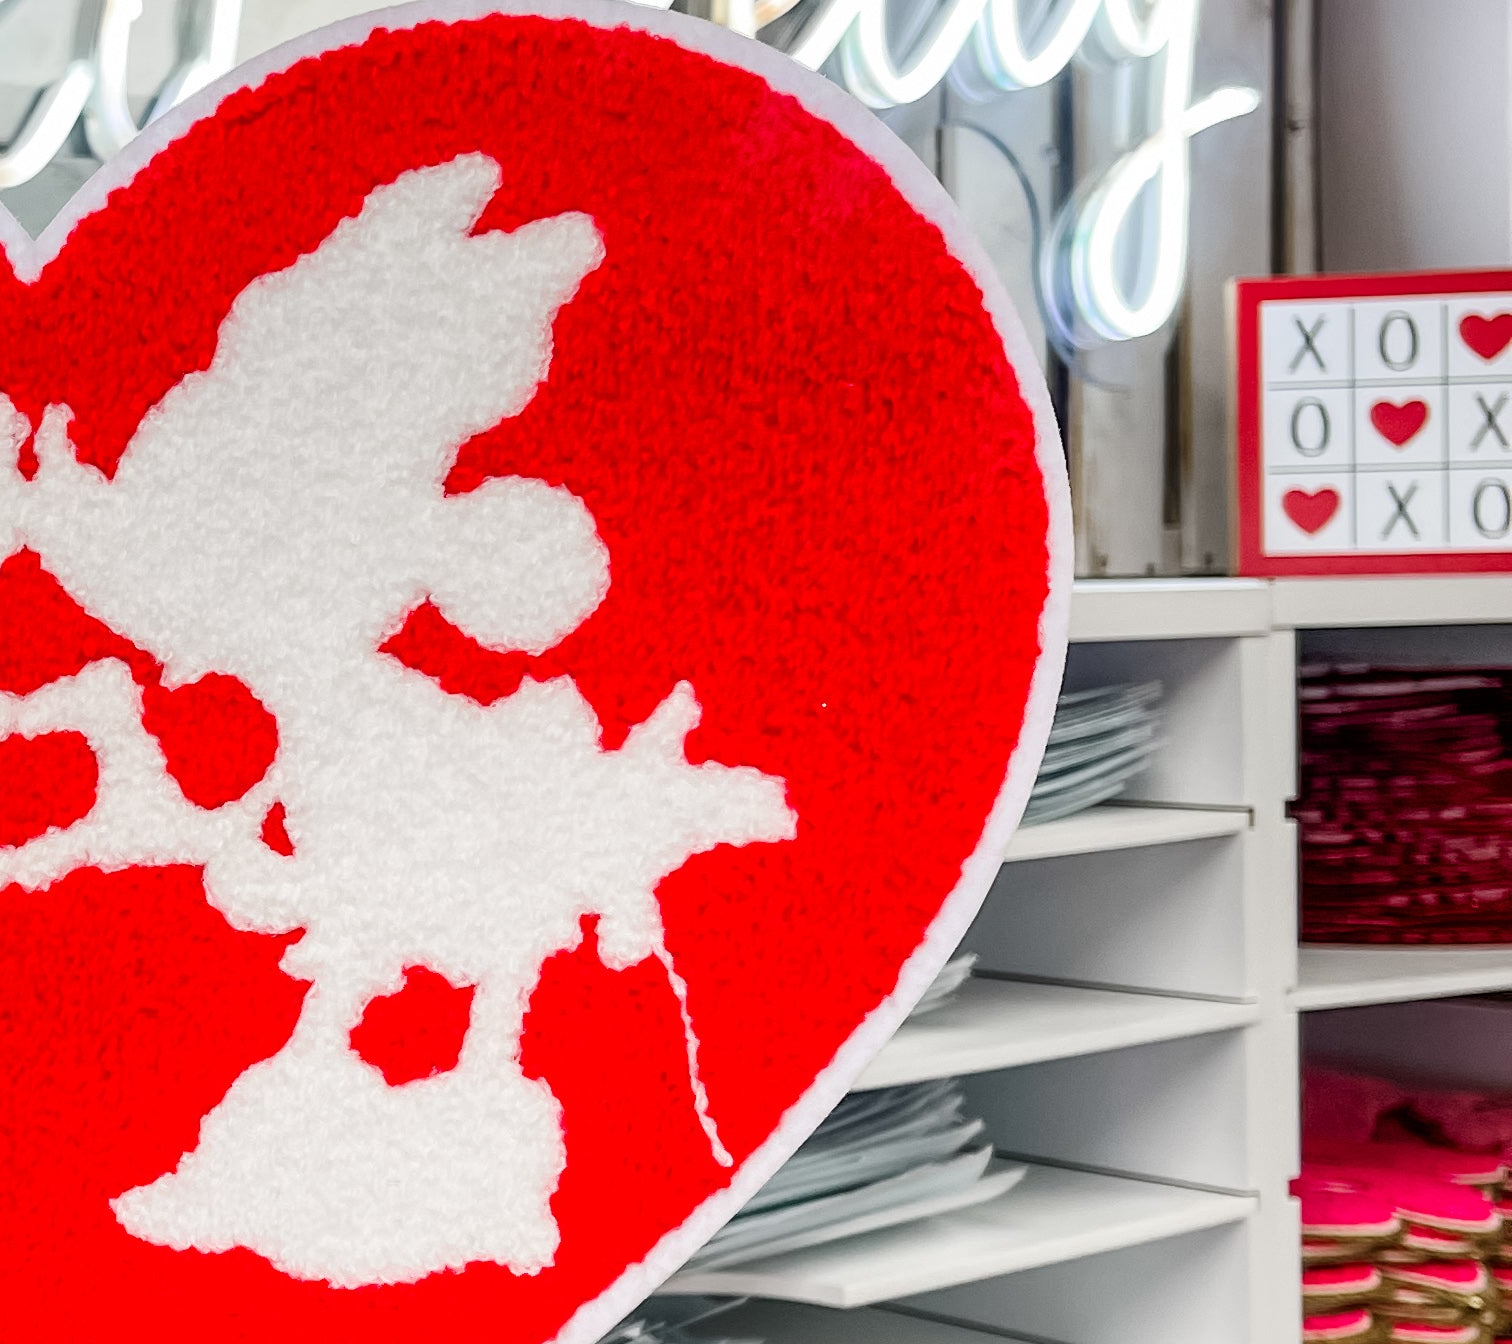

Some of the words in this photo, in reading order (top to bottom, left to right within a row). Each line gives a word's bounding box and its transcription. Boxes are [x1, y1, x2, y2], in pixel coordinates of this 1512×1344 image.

[1288, 312, 1328, 374] X
[1378, 309, 1420, 372] O
[1290, 396, 1332, 458] O
[1469, 391, 1510, 454] X
[1380, 478, 1421, 542] X
